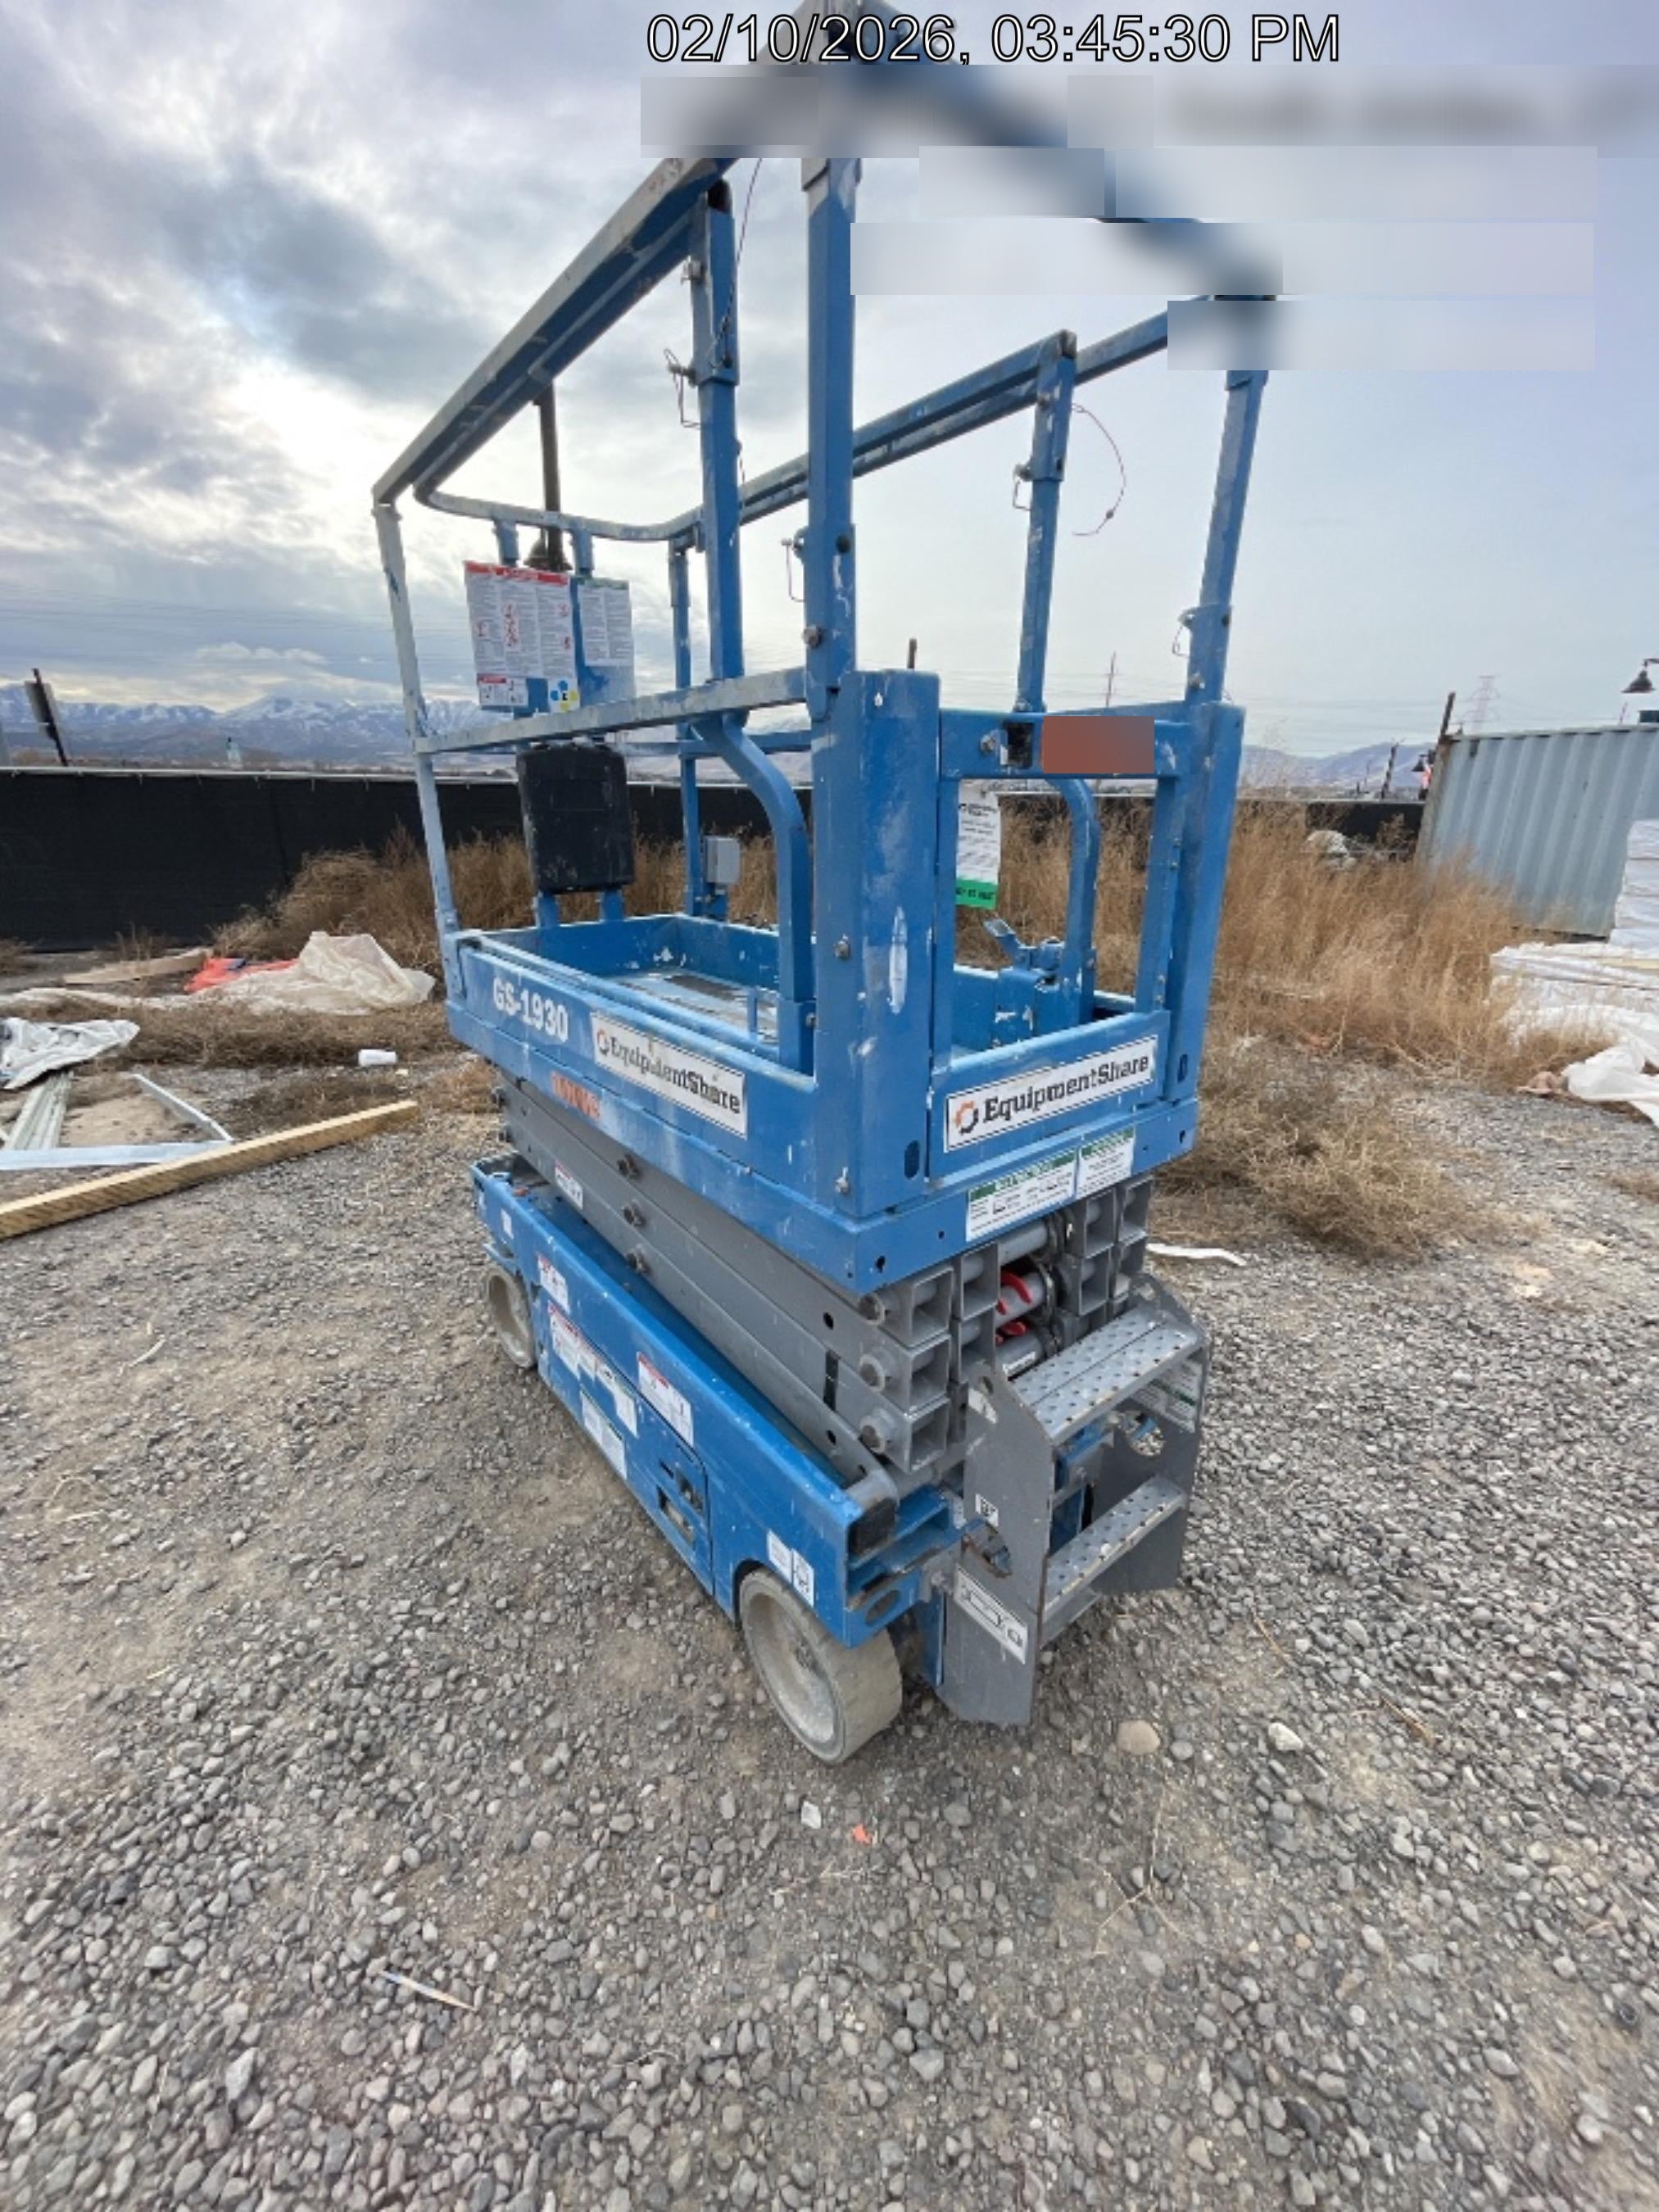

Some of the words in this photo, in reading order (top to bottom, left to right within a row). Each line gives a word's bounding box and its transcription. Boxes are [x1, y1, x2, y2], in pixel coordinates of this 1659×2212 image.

[493, 977, 569, 1043] GS-1930
[610, 1036, 741, 1114] EquipmentShare
[983, 1055, 1149, 1122] EquipmentShare
